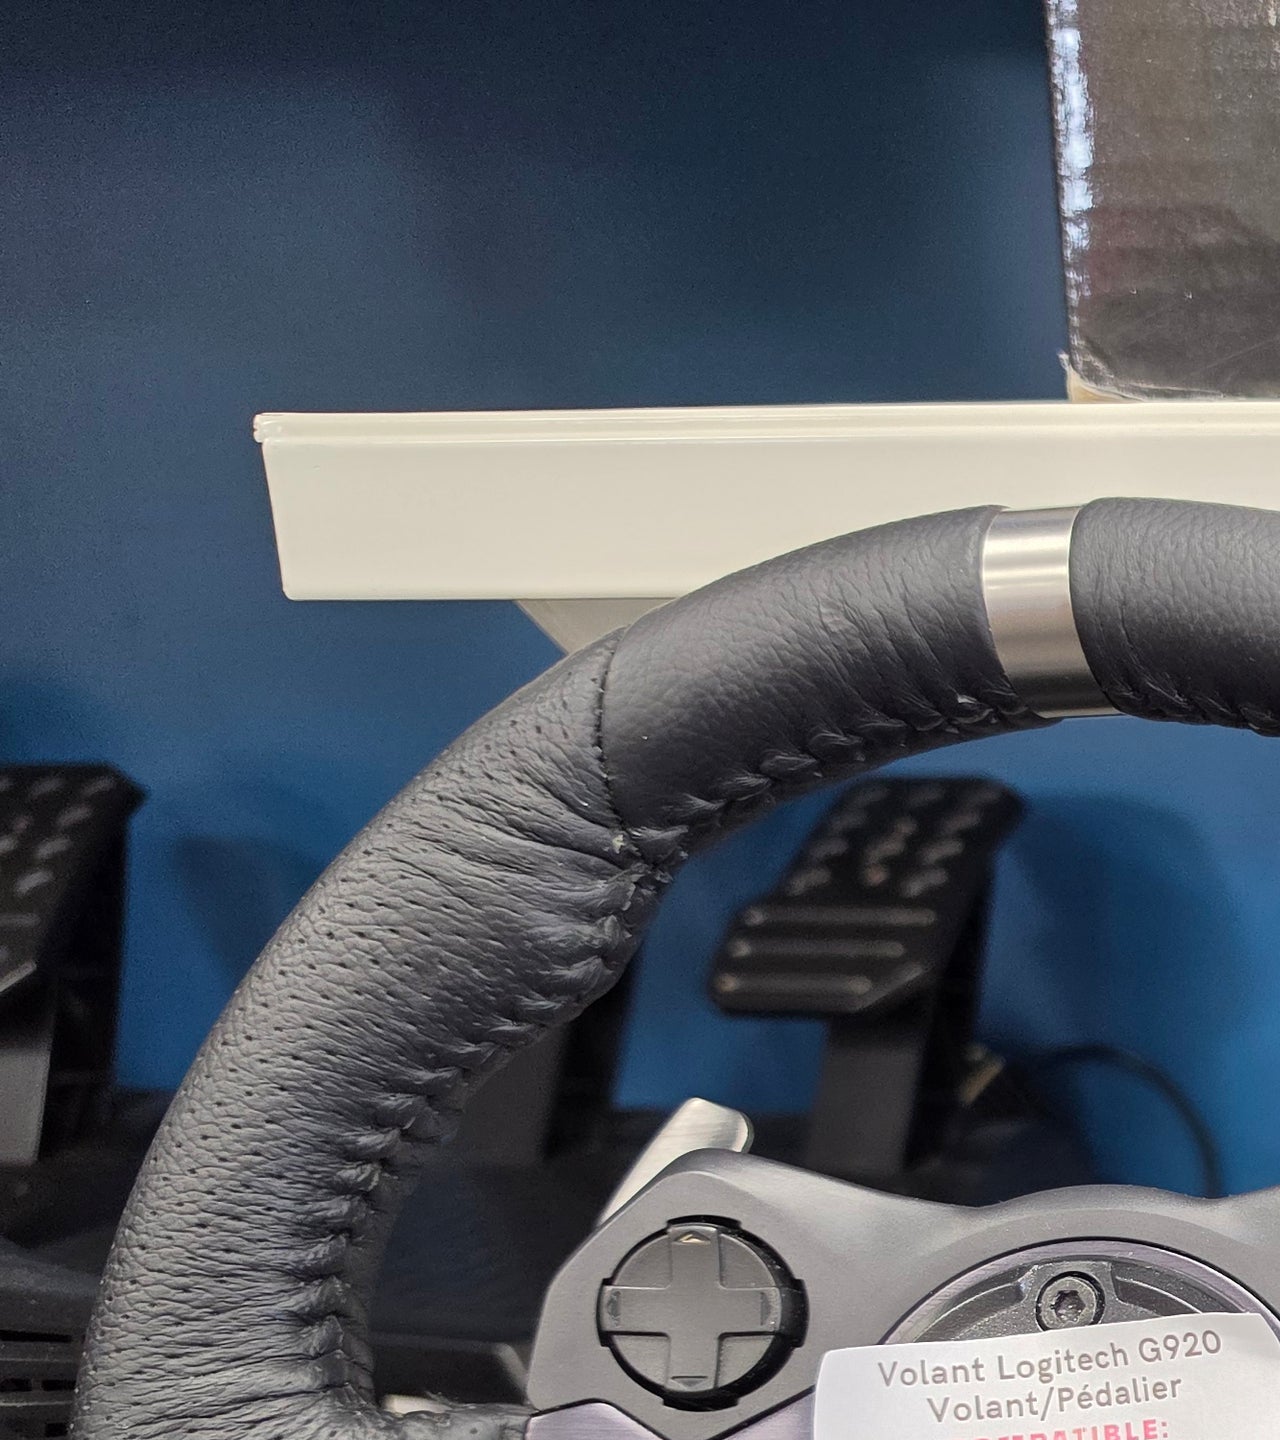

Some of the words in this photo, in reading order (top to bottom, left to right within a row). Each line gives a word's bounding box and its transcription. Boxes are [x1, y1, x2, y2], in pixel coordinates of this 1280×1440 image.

[878, 1357, 986, 1386] Volant
[998, 1342, 1129, 1385] Logitech
[1139, 1329, 1222, 1363] G920
[927, 1375, 1182, 1422] Volant/Pédalier
